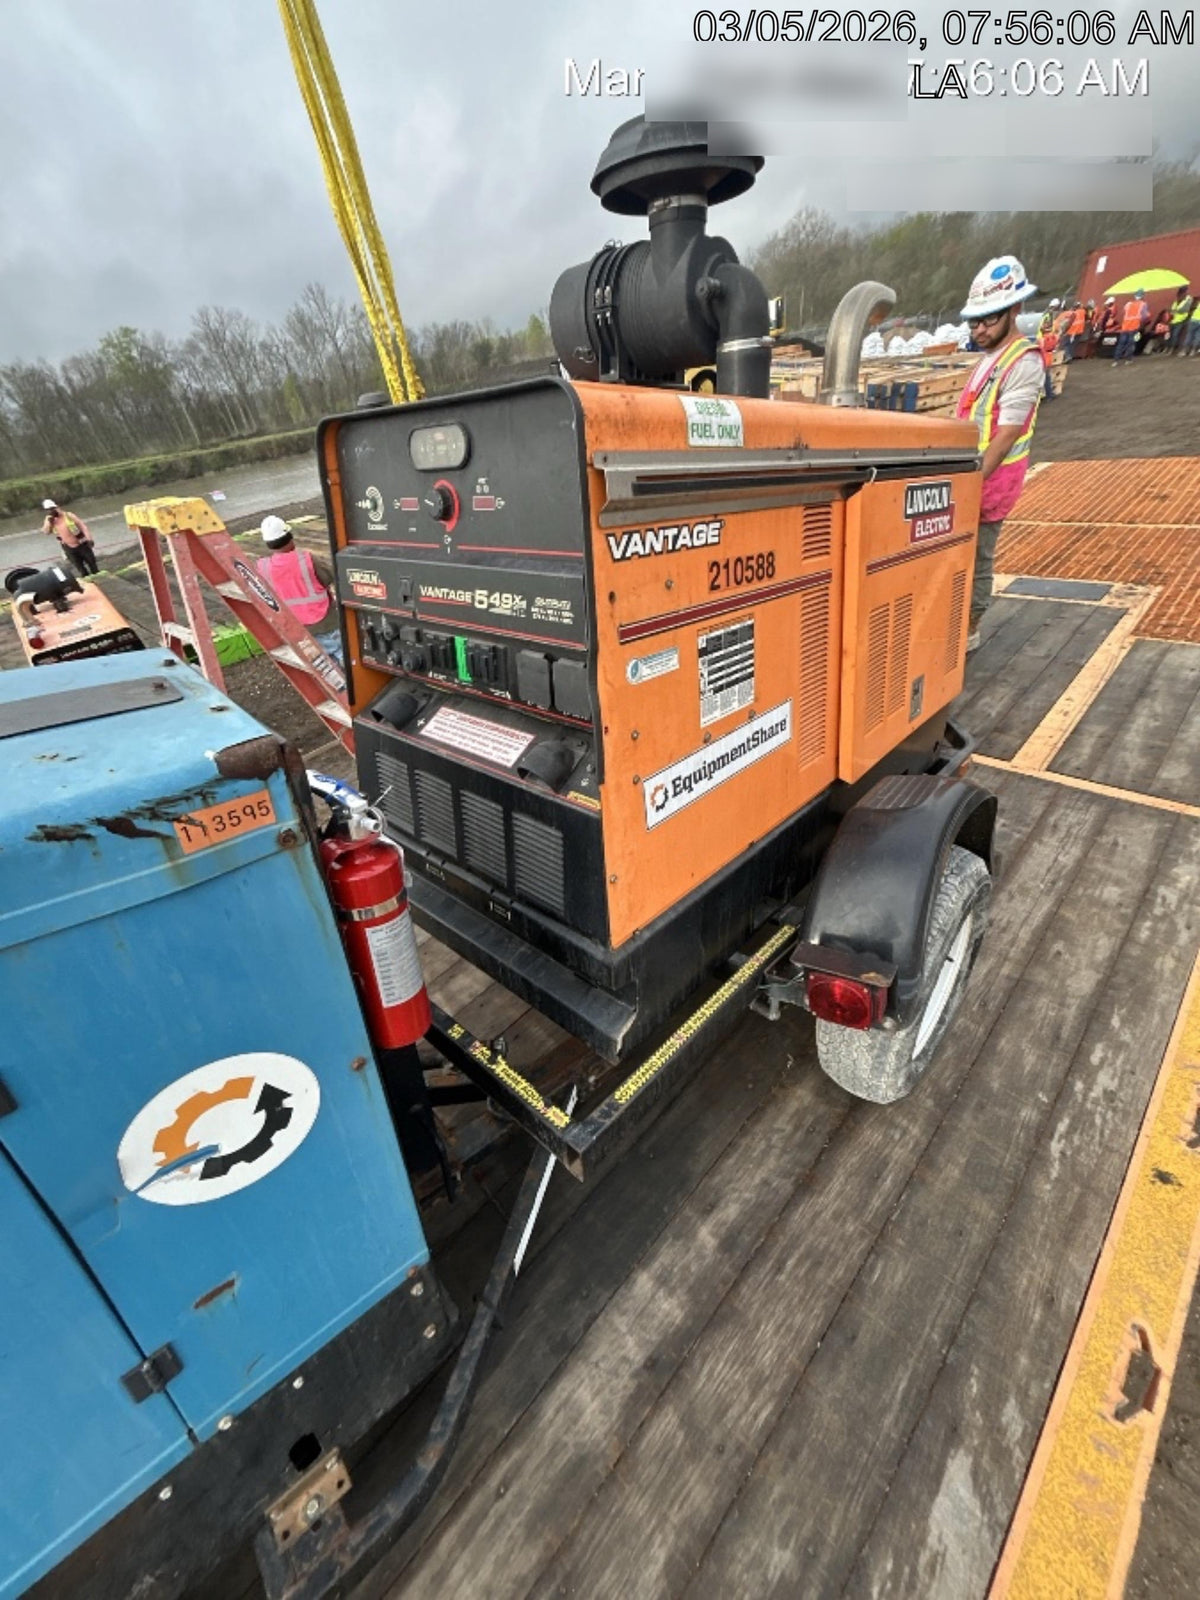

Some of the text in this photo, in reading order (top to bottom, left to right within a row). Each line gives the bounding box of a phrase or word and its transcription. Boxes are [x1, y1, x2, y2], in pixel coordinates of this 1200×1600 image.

[691, 422, 741, 440] FUEL ONLY
[906, 486, 950, 515] LINCOLN
[607, 521, 723, 561] VANTAGE
[914, 514, 951, 538] ELECTRIC
[709, 550, 775, 591] 210588
[419, 584, 472, 604] VANTAGE
[671, 717, 788, 798] EquipmentShare
[180, 799, 271, 843] 113595
